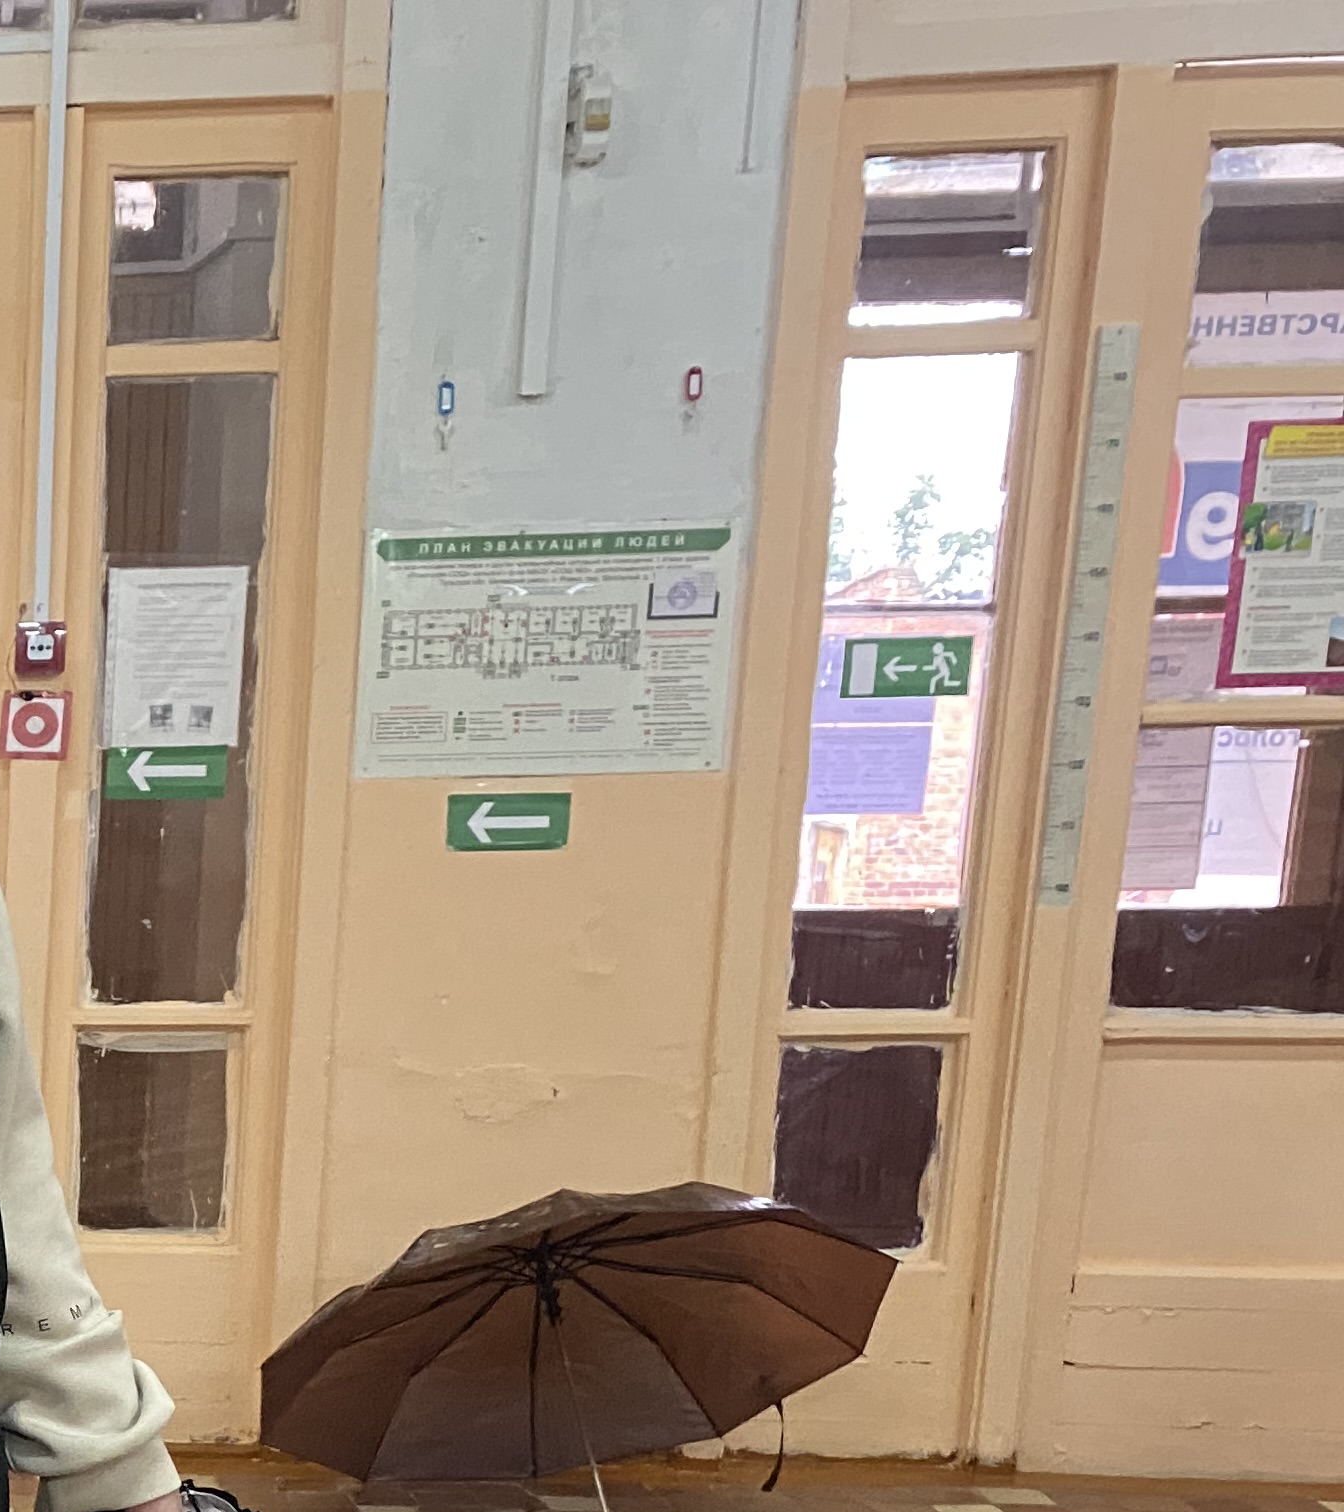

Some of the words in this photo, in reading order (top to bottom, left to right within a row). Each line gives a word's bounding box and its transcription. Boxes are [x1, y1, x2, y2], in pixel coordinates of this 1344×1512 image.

[419, 542, 471, 554] ПЛАН
[483, 537, 602, 552] ЭВАКУАЦИИ
[614, 533, 686, 548] ЛЮДЕЙ
